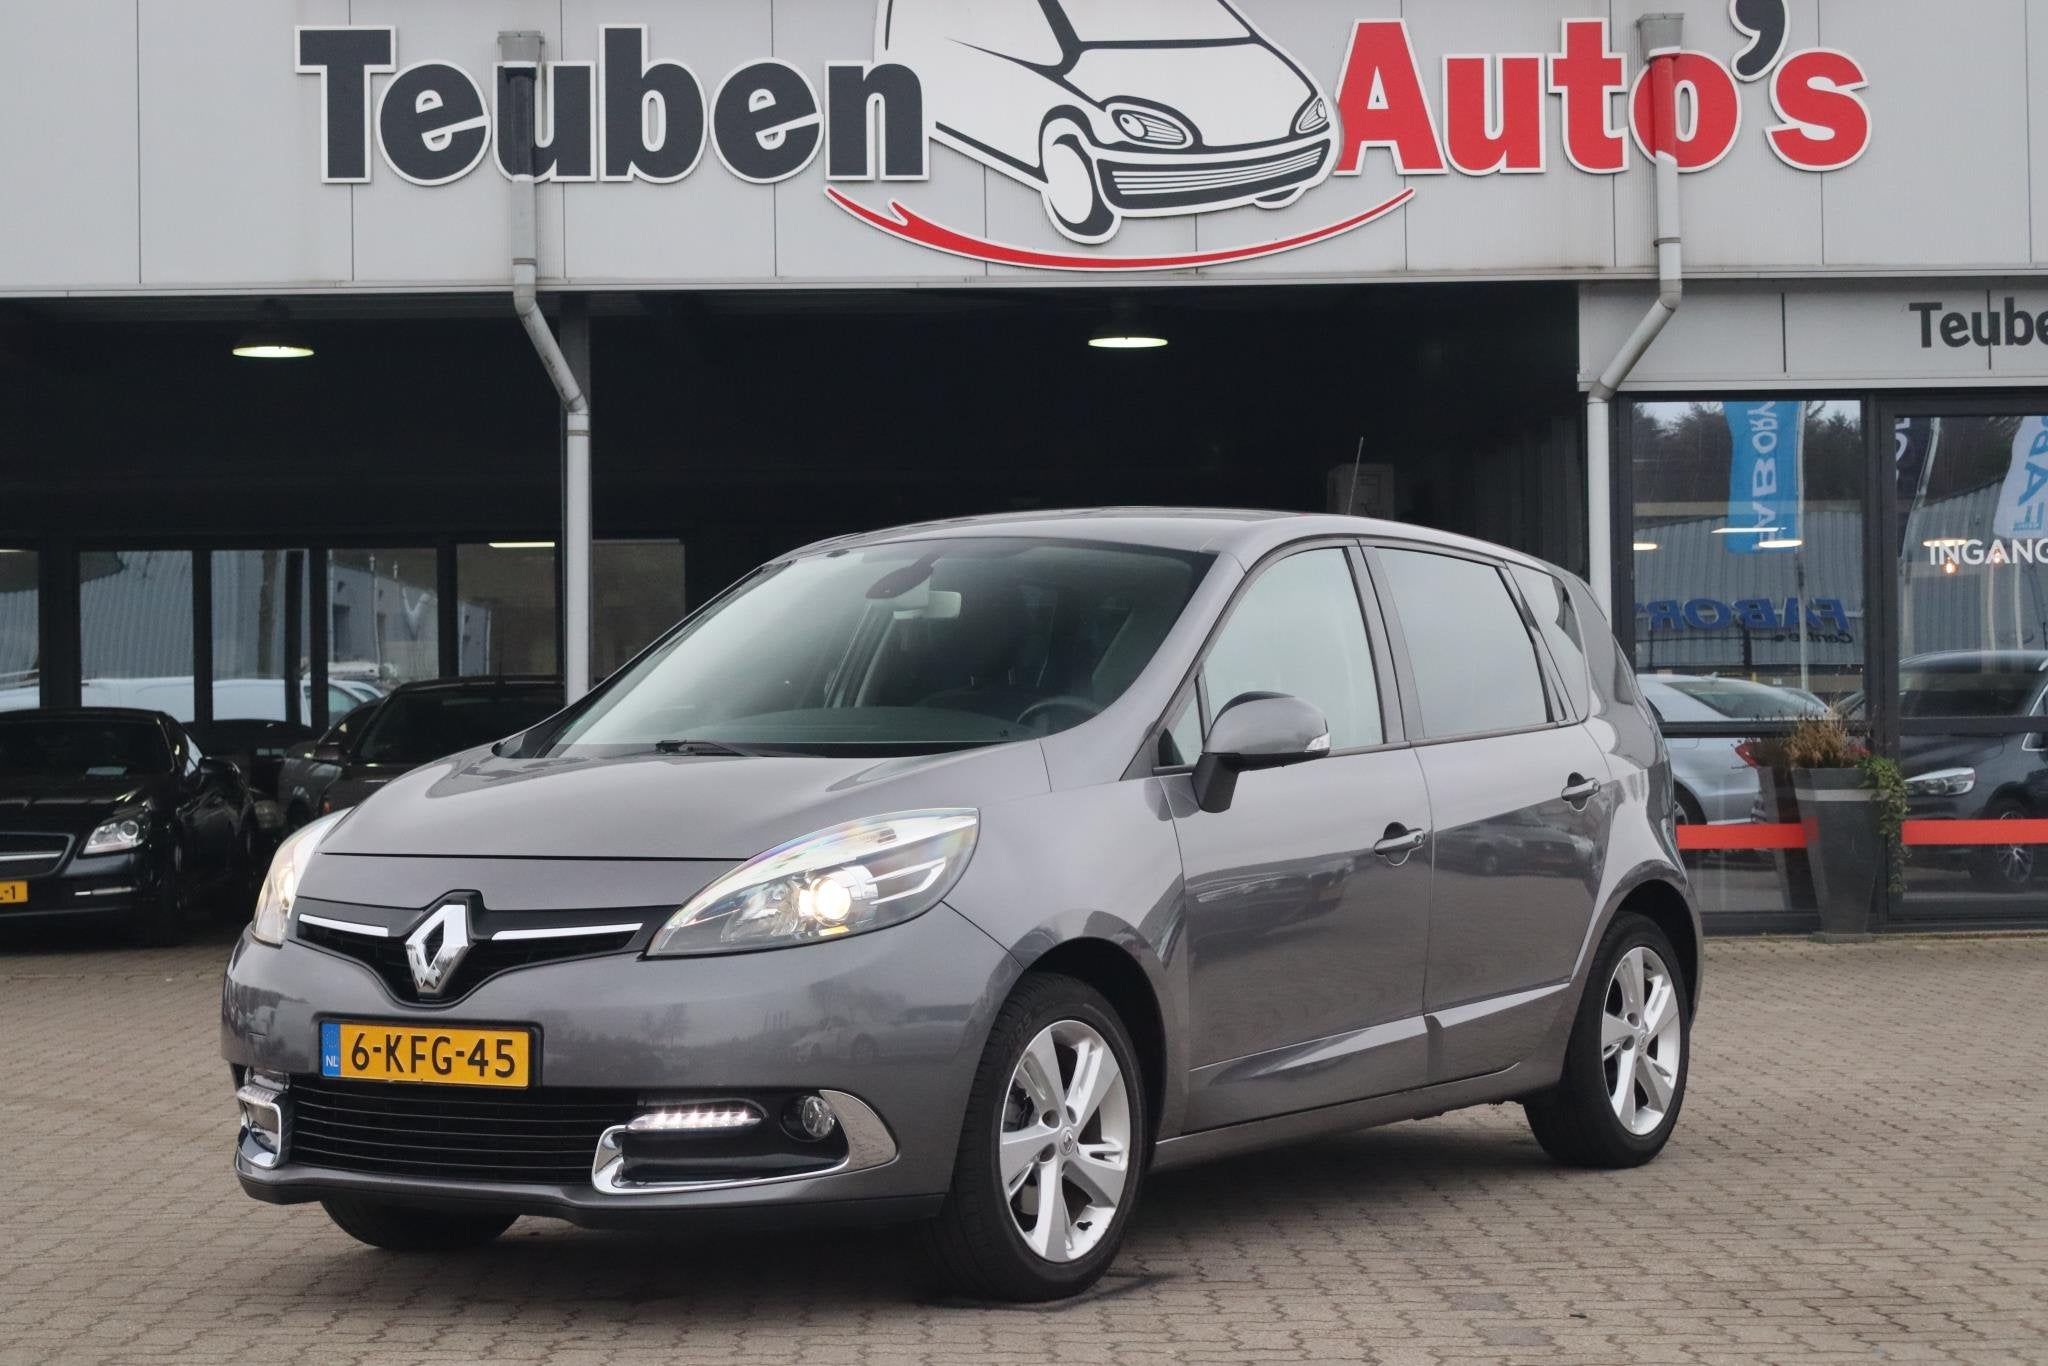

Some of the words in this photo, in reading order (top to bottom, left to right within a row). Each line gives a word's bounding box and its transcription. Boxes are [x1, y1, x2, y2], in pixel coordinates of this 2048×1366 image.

[294, 24, 929, 186] Teuben
[1334, 0, 1872, 176] Auto's
[326, 1057, 339, 1069] NL
[351, 1033, 516, 1078] 6-KFG-45
